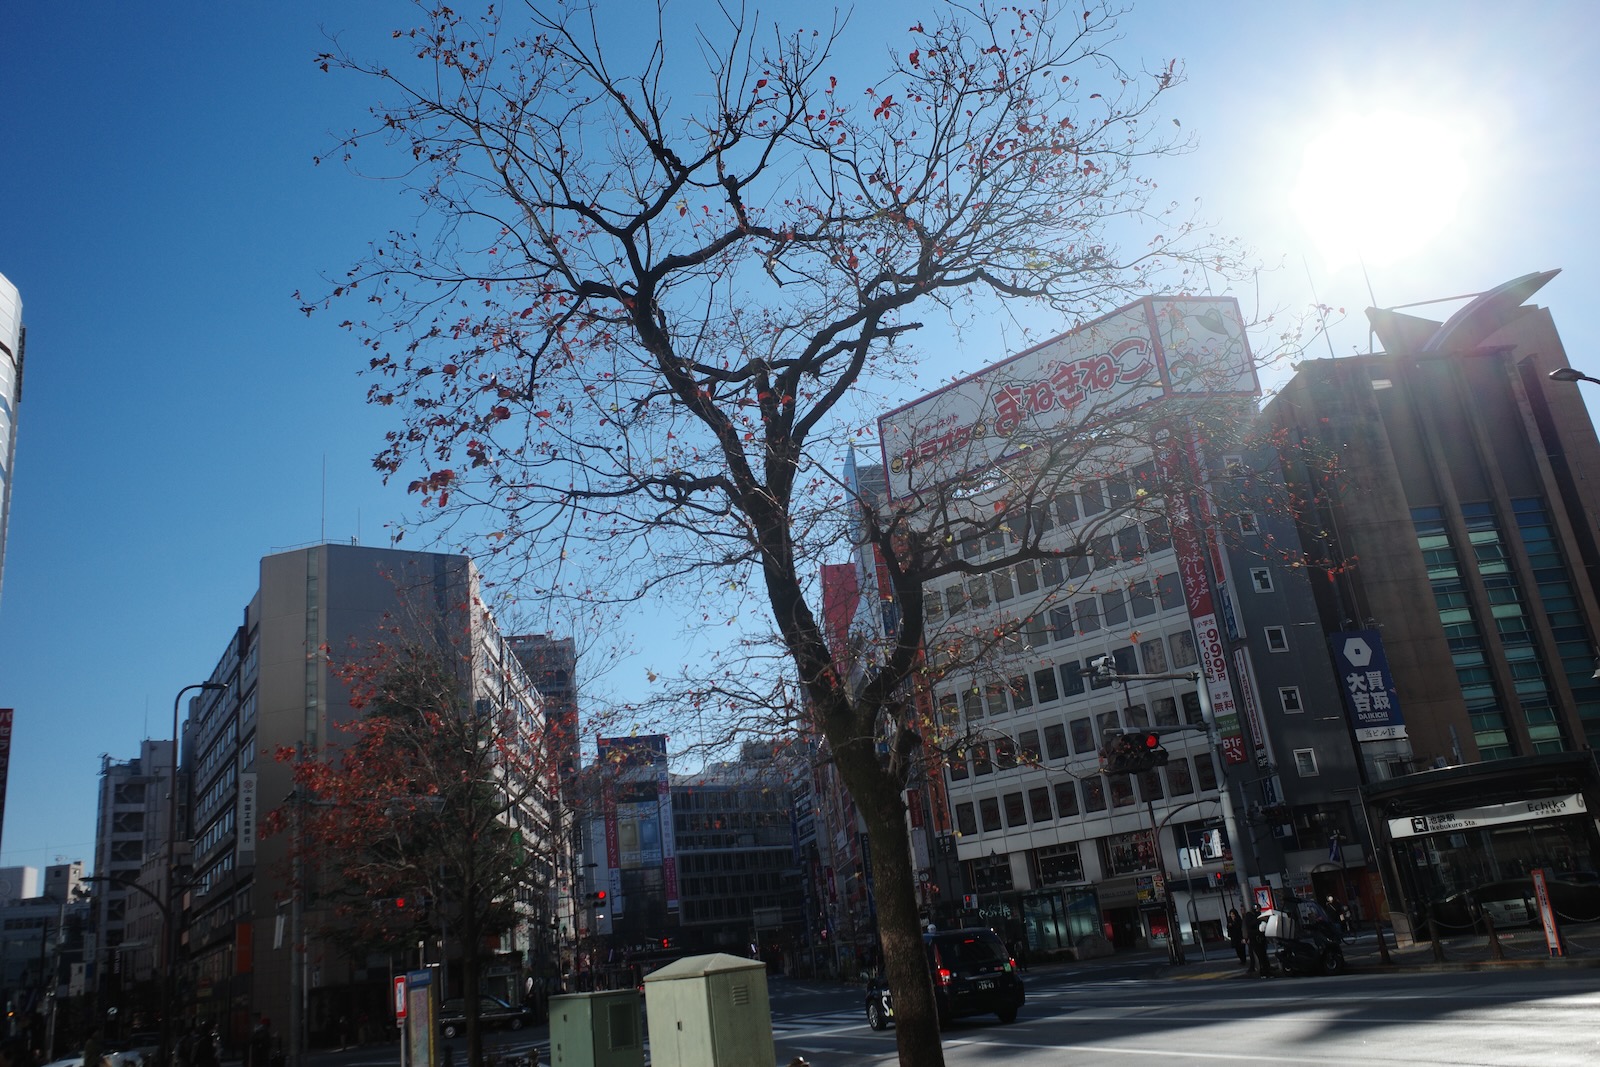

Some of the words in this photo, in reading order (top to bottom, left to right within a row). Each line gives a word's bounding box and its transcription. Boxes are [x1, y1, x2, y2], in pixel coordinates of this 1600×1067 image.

[991, 337, 1154, 437] まねきねこ
[1213, 700, 1235, 713] 無料
[1358, 711, 1389, 721] DAIKICHI
[1222, 737, 1242, 750] B1F
[1527, 800, 1566, 813] Echika
[1429, 813, 1456, 824] 池袋駅
[1429, 822, 1463, 832] Ikebukuro
[1464, 820, 1478, 828] Sta.
